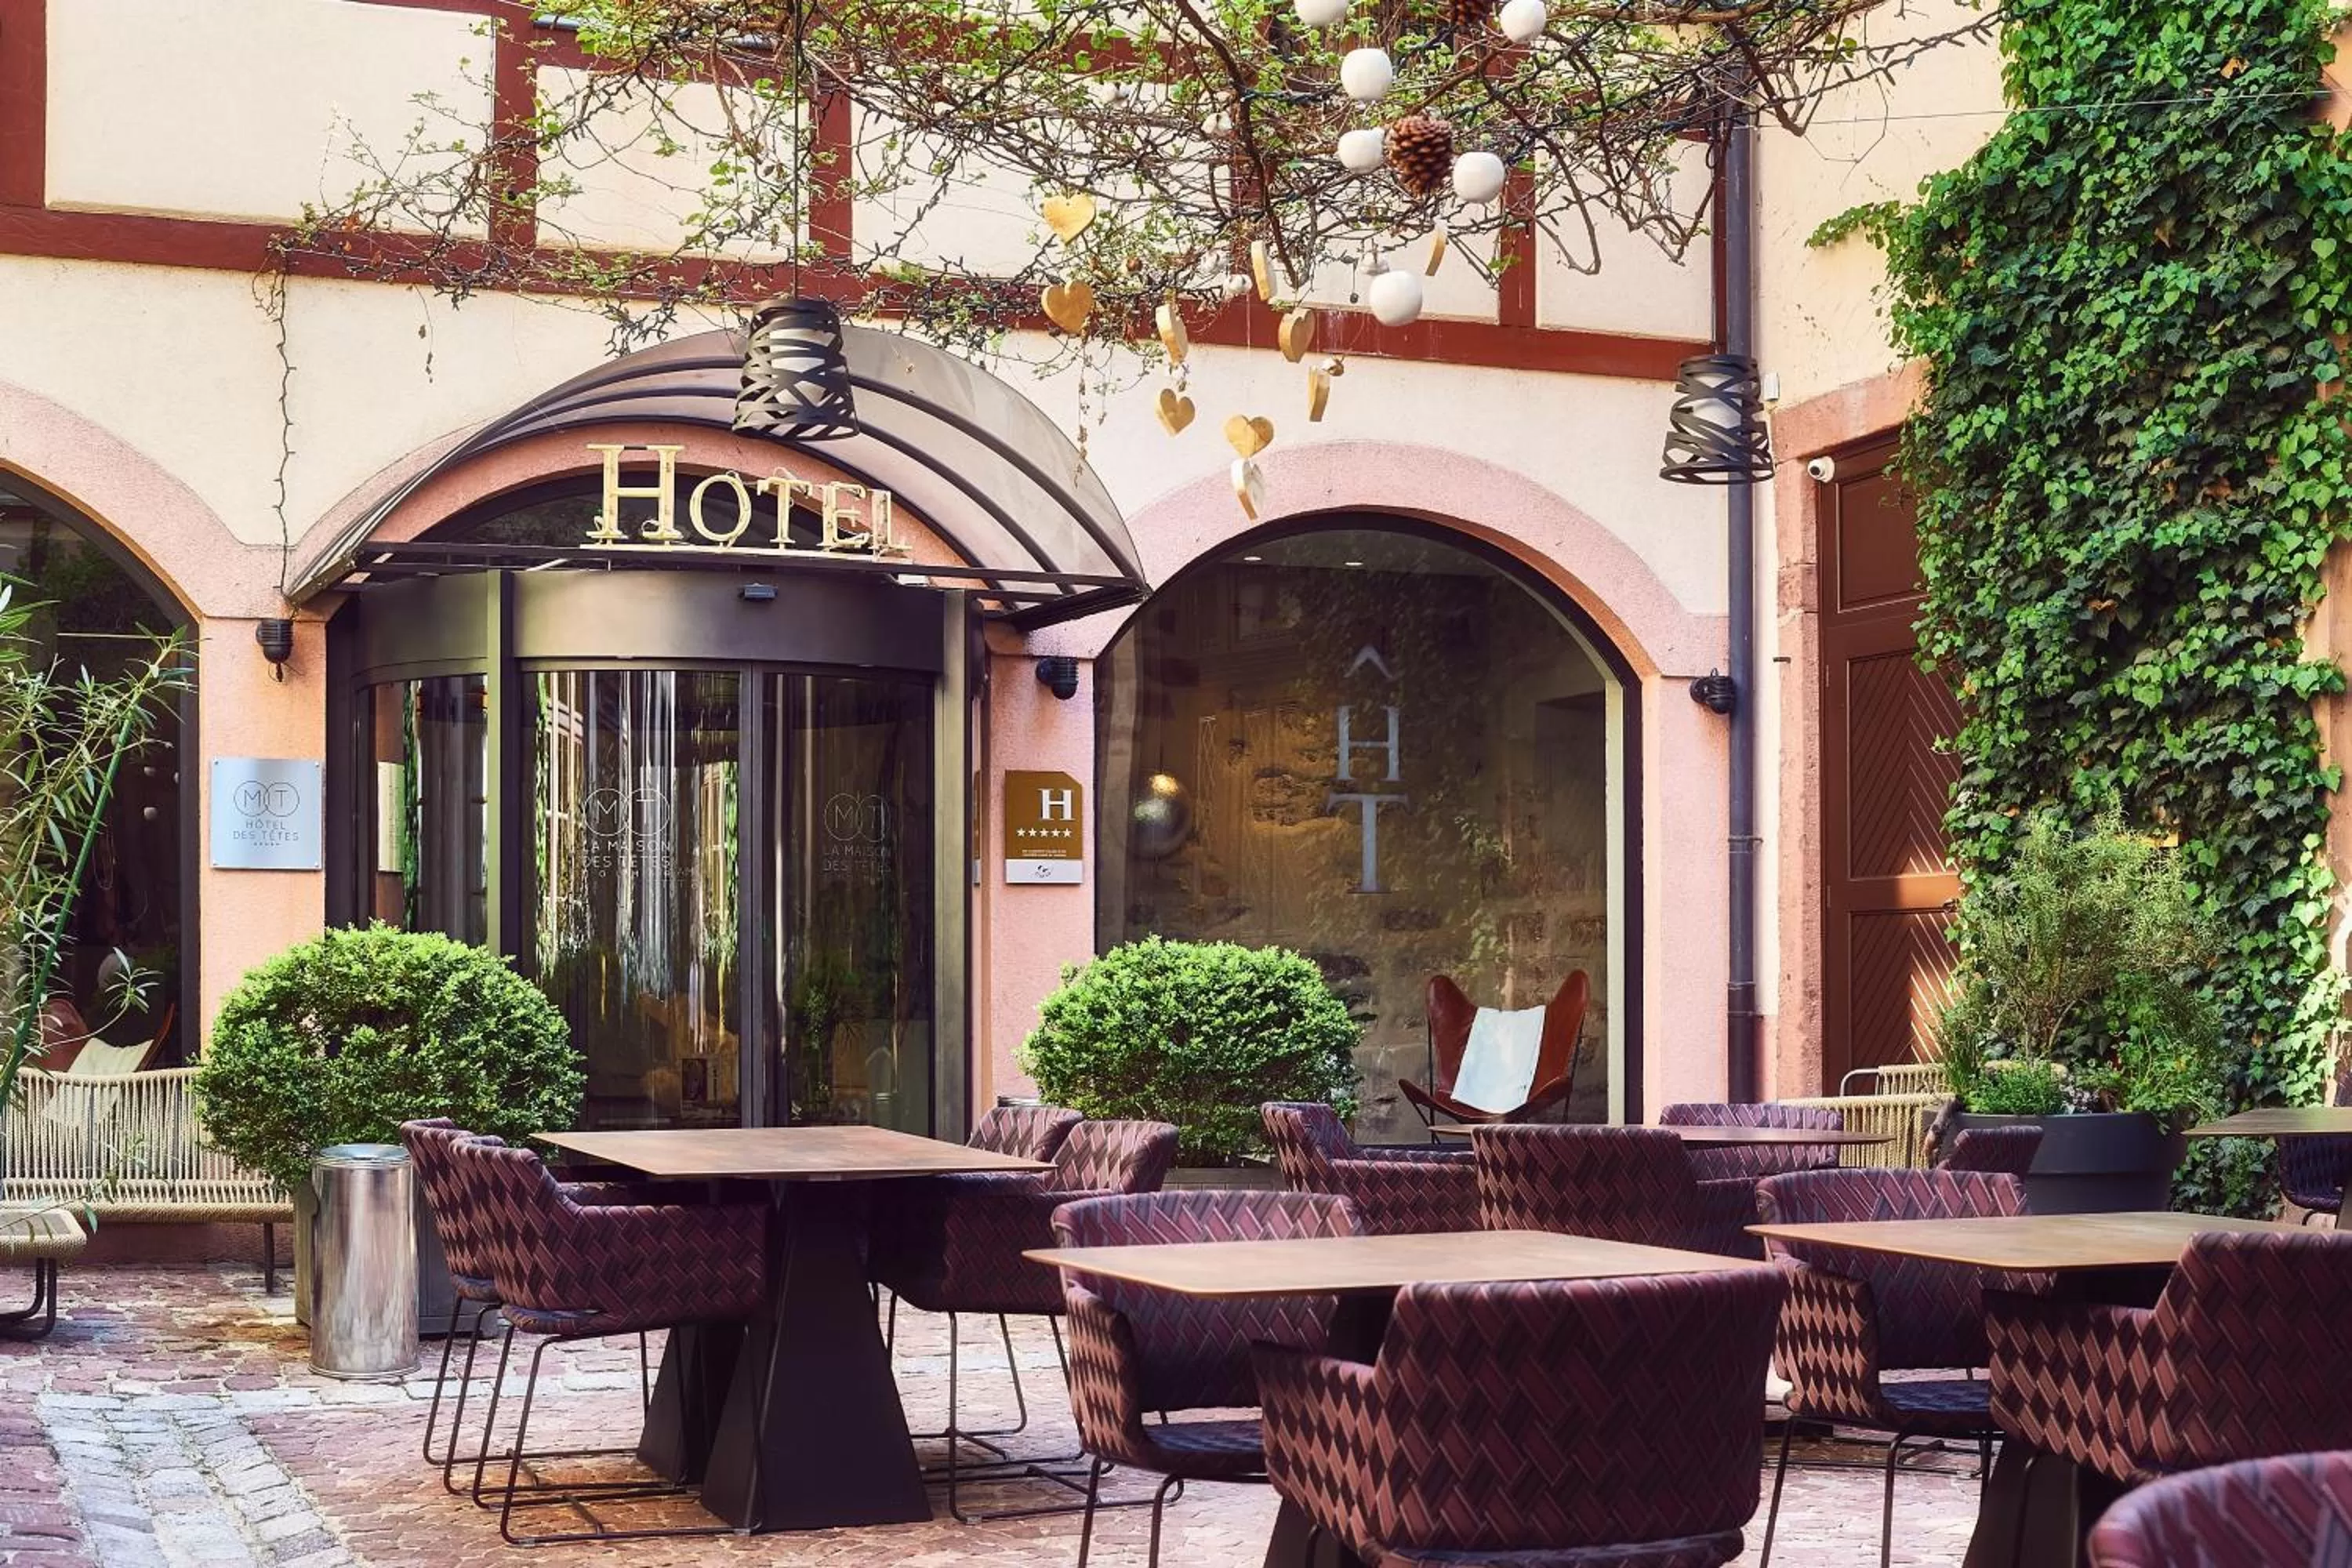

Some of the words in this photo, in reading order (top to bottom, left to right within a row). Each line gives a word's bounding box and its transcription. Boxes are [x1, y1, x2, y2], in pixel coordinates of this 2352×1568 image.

[586, 444, 913, 552] HOTEL
[1038, 788, 1076, 821] H
[245, 818, 286, 830] HÔTEL
[233, 830, 256, 840] DES
[608, 840, 671, 852] MASON
